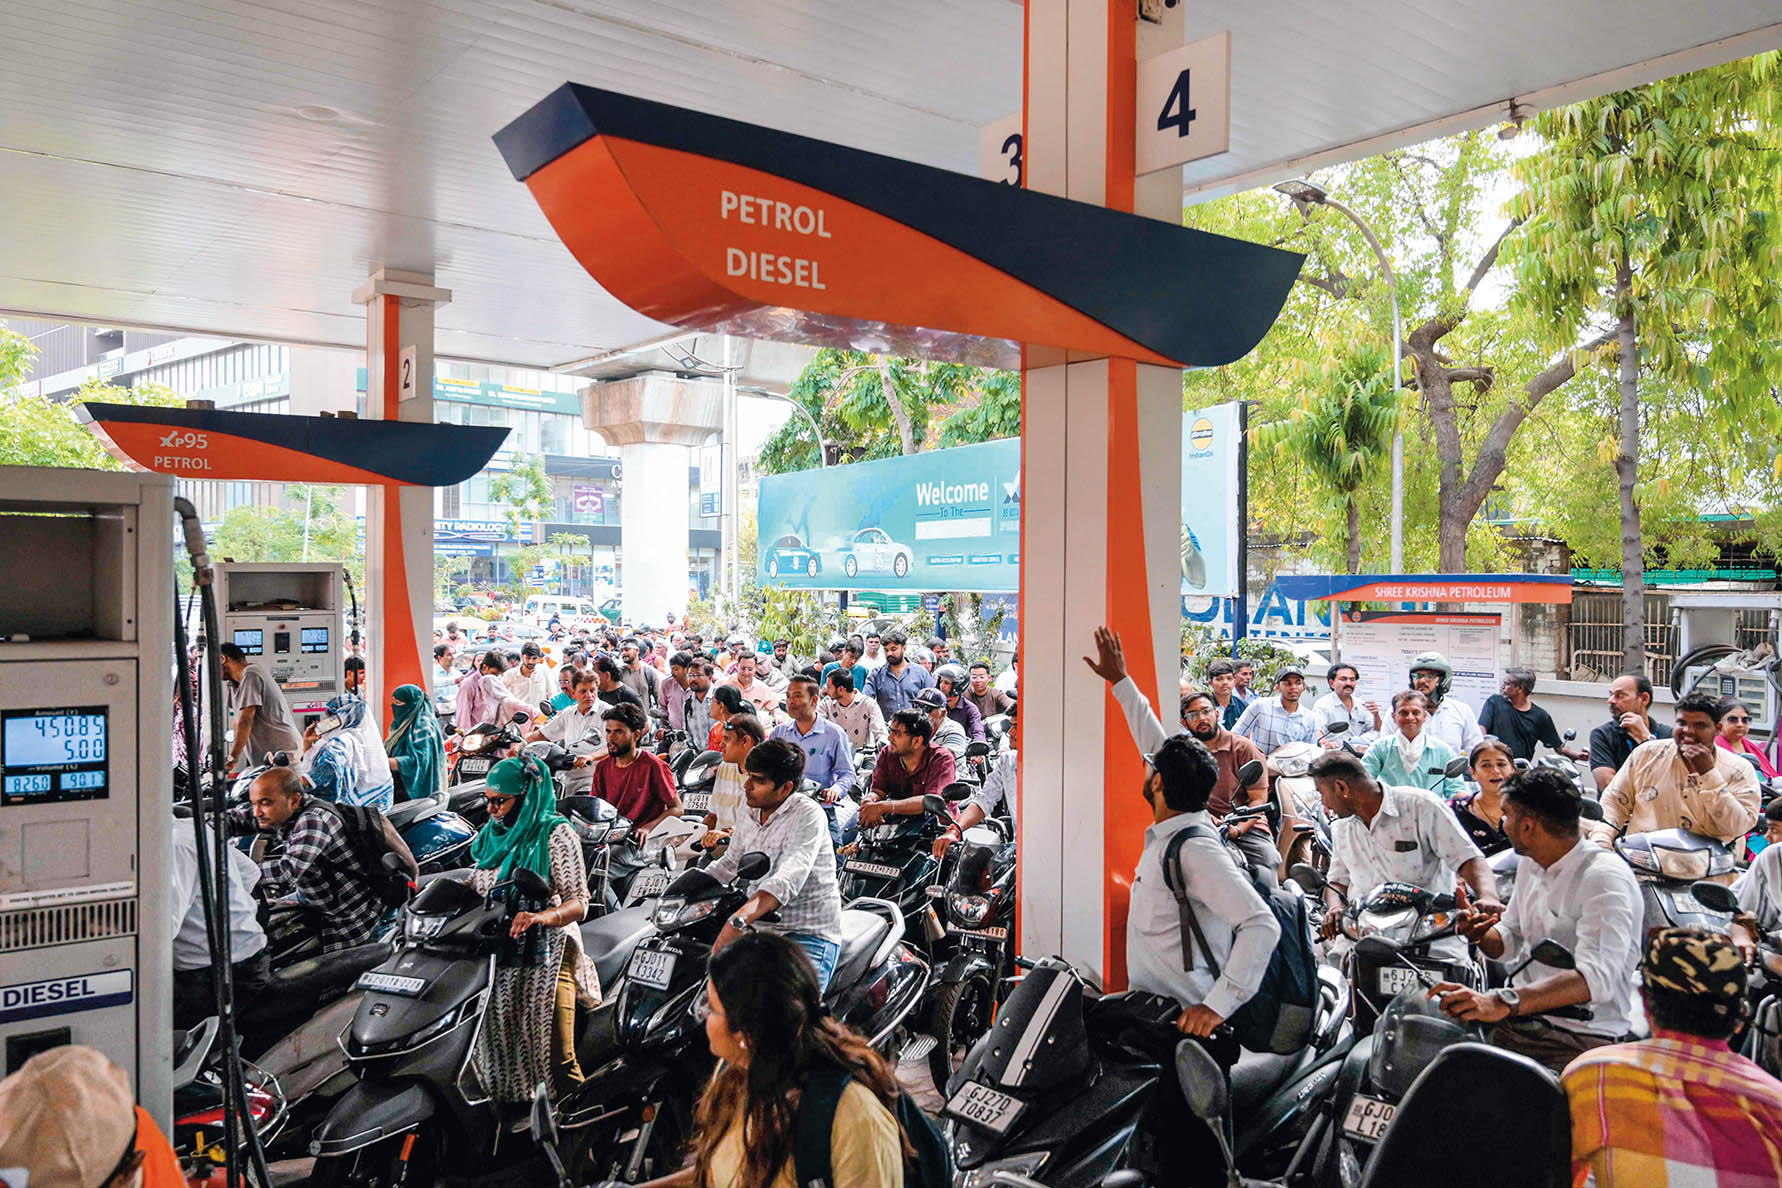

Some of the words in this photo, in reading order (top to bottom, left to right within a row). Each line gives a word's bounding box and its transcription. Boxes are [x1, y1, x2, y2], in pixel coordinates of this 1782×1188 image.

[1157, 68, 1197, 138] 4
[1001, 133, 1023, 188] 3
[721, 190, 832, 239] PETROL
[727, 247, 827, 290] DIESEL
[403, 358, 411, 389] 2
[154, 455, 212, 470] PETROL
[916, 480, 989, 507] Welcome
[940, 507, 949, 518] To
[951, 506, 964, 517] The
[1375, 586, 1403, 598] SHREE
[1405, 586, 1447, 598] KRISHNA
[1449, 586, 1511, 598] PETROLEUM
[3, 979, 96, 1008] DIESEL
[959, 1100, 1002, 1124] T0837
